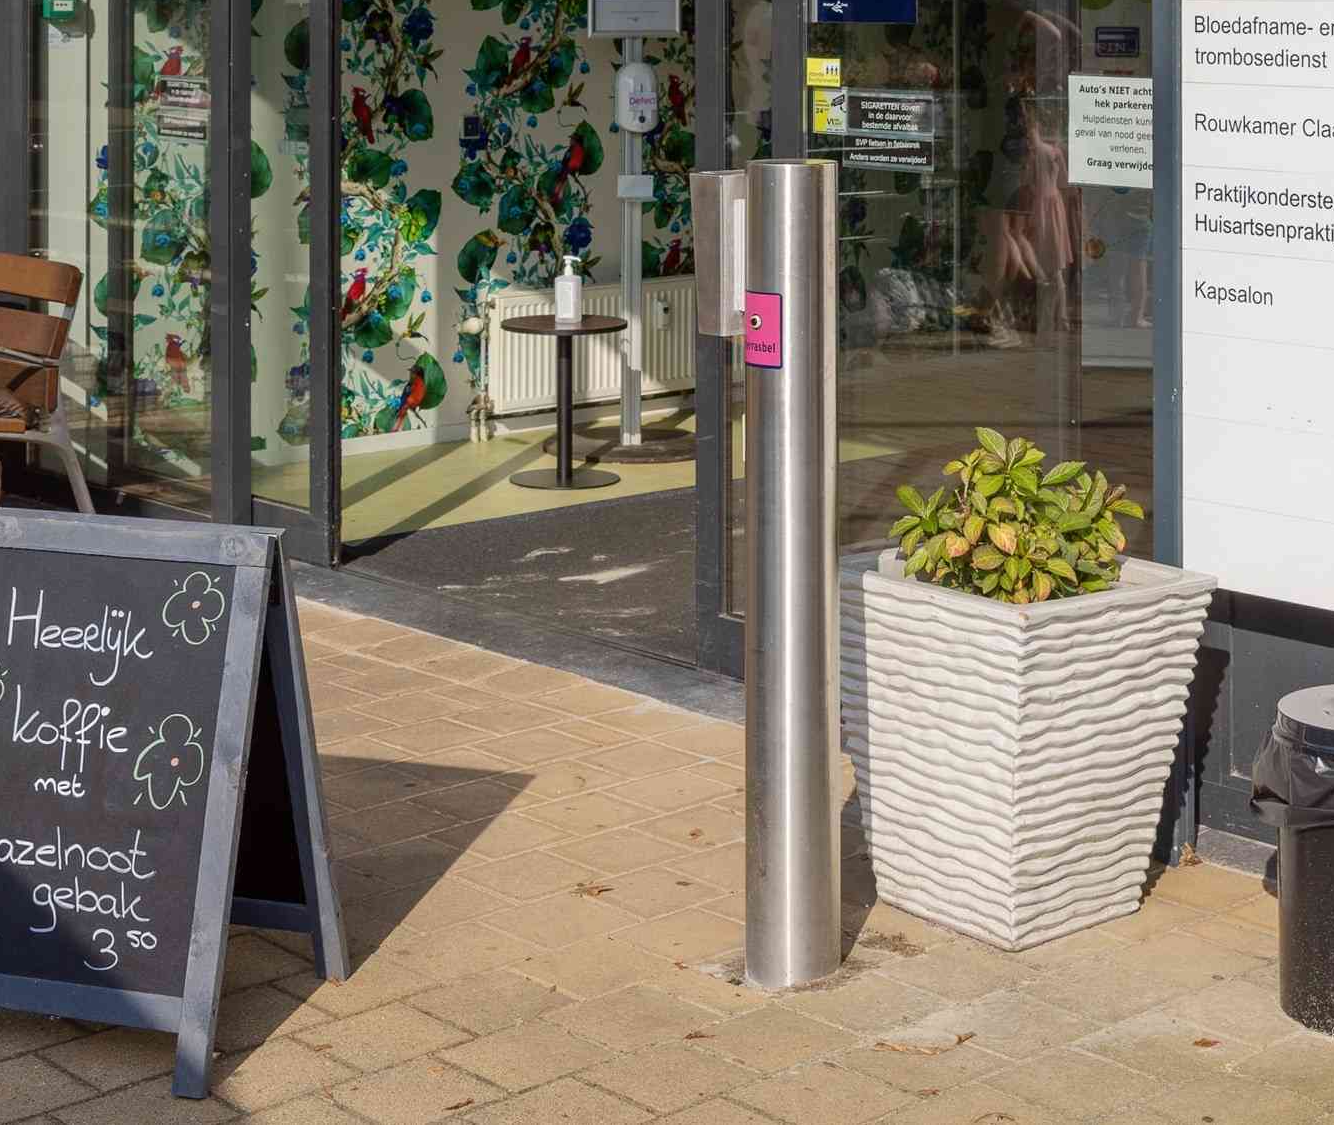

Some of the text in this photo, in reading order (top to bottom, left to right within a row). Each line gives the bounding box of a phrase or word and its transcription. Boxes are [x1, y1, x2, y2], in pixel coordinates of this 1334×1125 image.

[1194, 15, 1314, 37] Bloedafname-
[1194, 48, 1328, 70] trombosedienst
[1079, 85, 1107, 94] Auto's
[1109, 86, 1130, 95] NIET
[861, 101, 899, 111] SIGARETTEN
[1095, 98, 1153, 110] hek parkeren
[876, 112, 884, 120] de
[885, 112, 913, 121] daarvoor
[1083, 114, 1133, 125] Hulpdiensten
[1194, 113, 1297, 138] Rouwkamer
[1098, 129, 1112, 138] van
[1115, 130, 1134, 139] nood
[1087, 157, 1113, 169] Graag
[1194, 280, 1274, 308] Kapsalon
[746, 340, 776, 353] rrasbel
[12, 685, 129, 773] koffie
[34, 776, 85, 797] met
[29, 877, 151, 933] gebak
